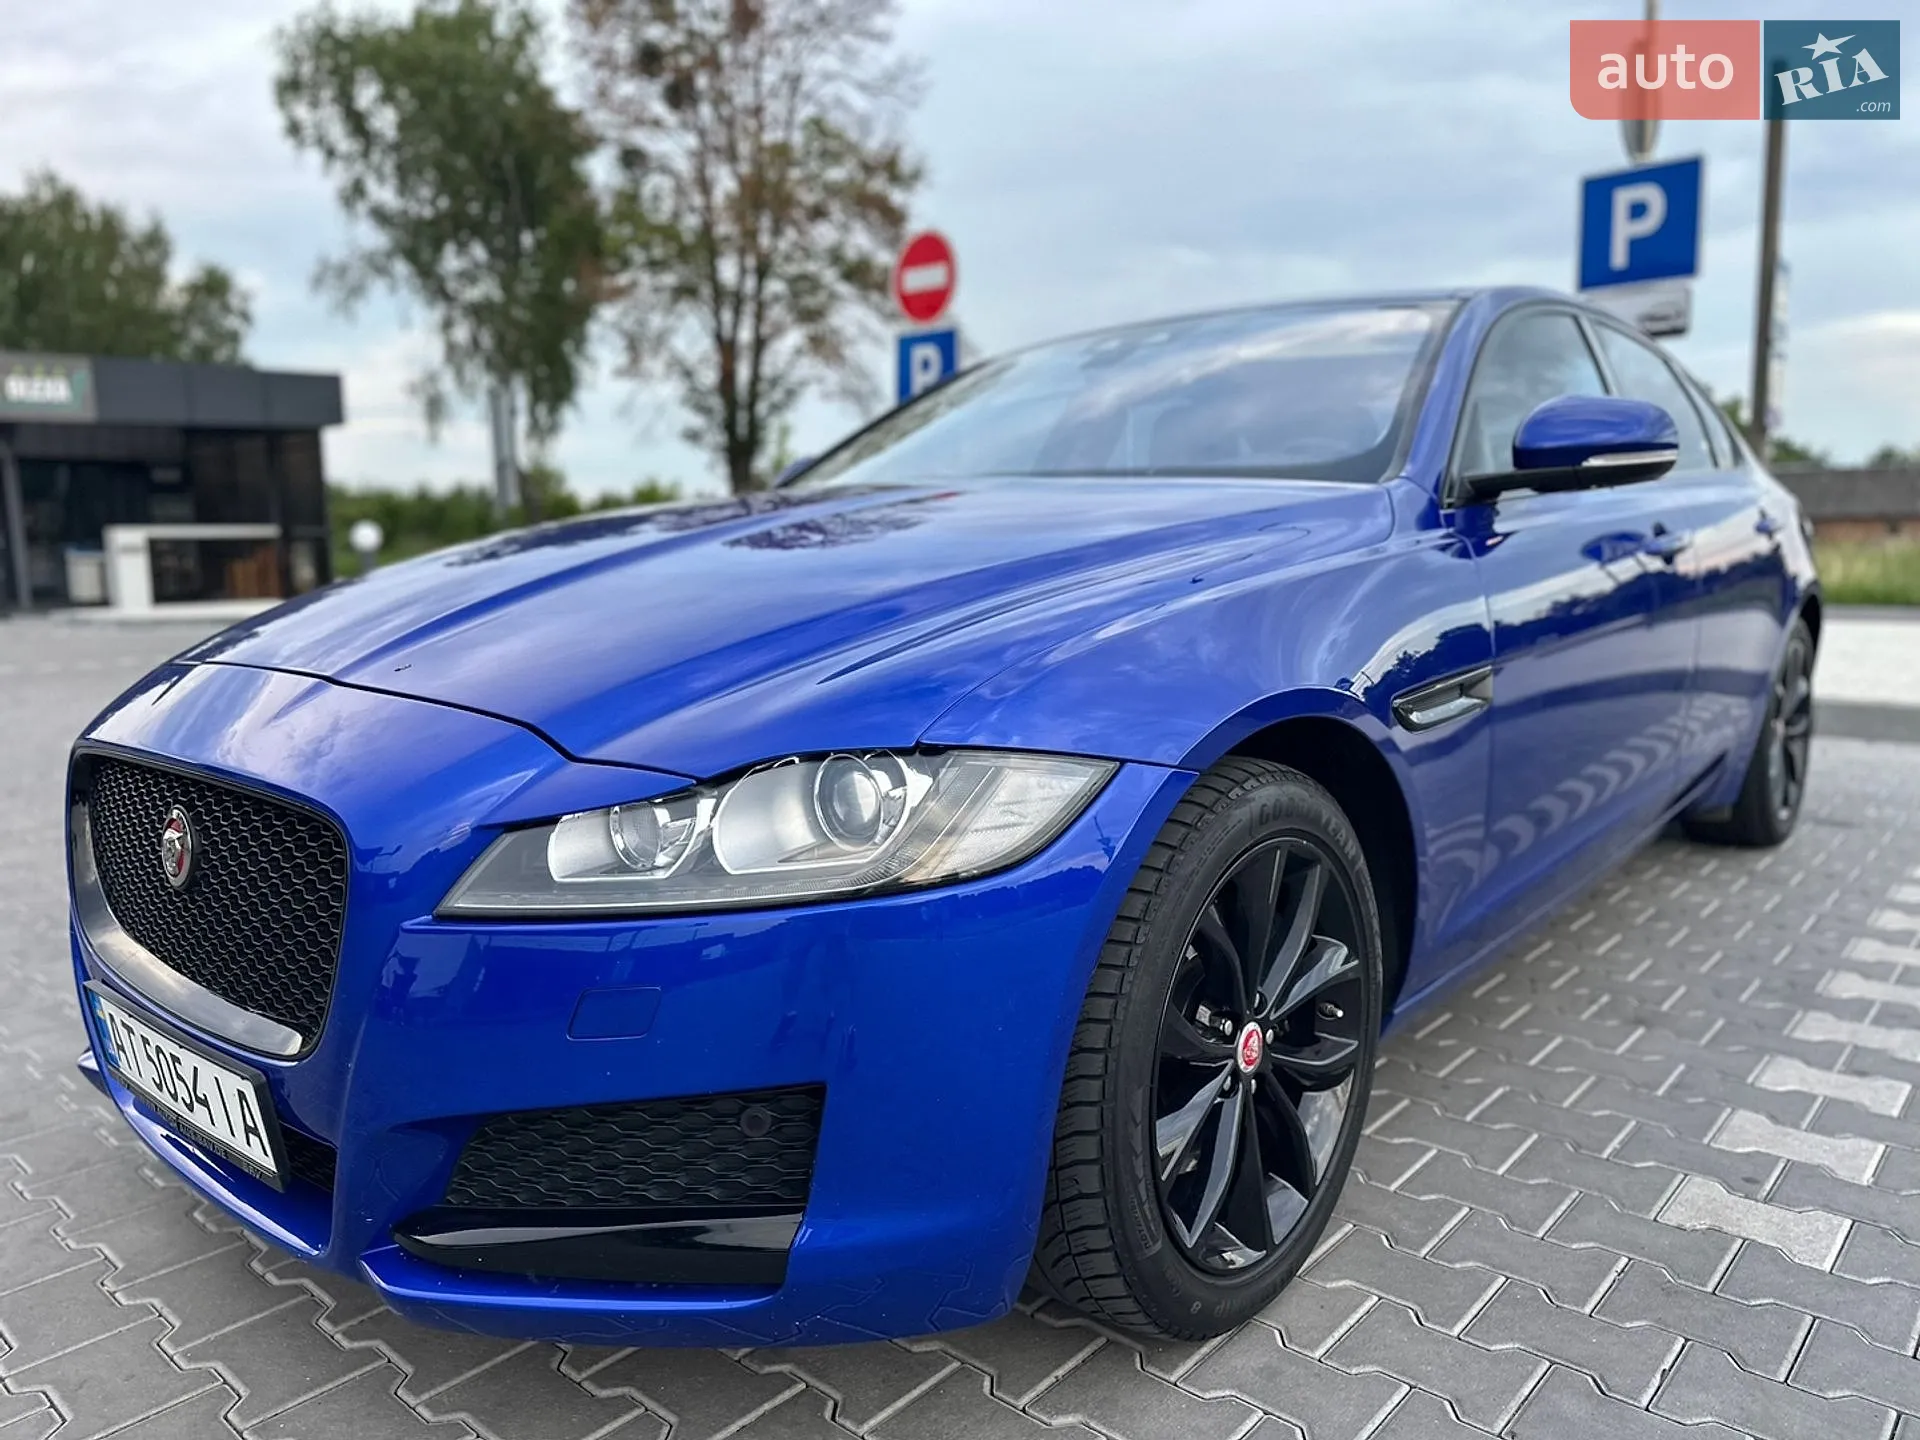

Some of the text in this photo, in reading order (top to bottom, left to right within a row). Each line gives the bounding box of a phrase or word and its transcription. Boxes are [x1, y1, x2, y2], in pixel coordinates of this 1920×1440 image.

[1609, 181, 1668, 272] P
[909, 341, 943, 396] P
[108, 1011, 143, 1079] AT
[140, 1034, 216, 1128] 5054
[214, 1075, 270, 1158] IA
